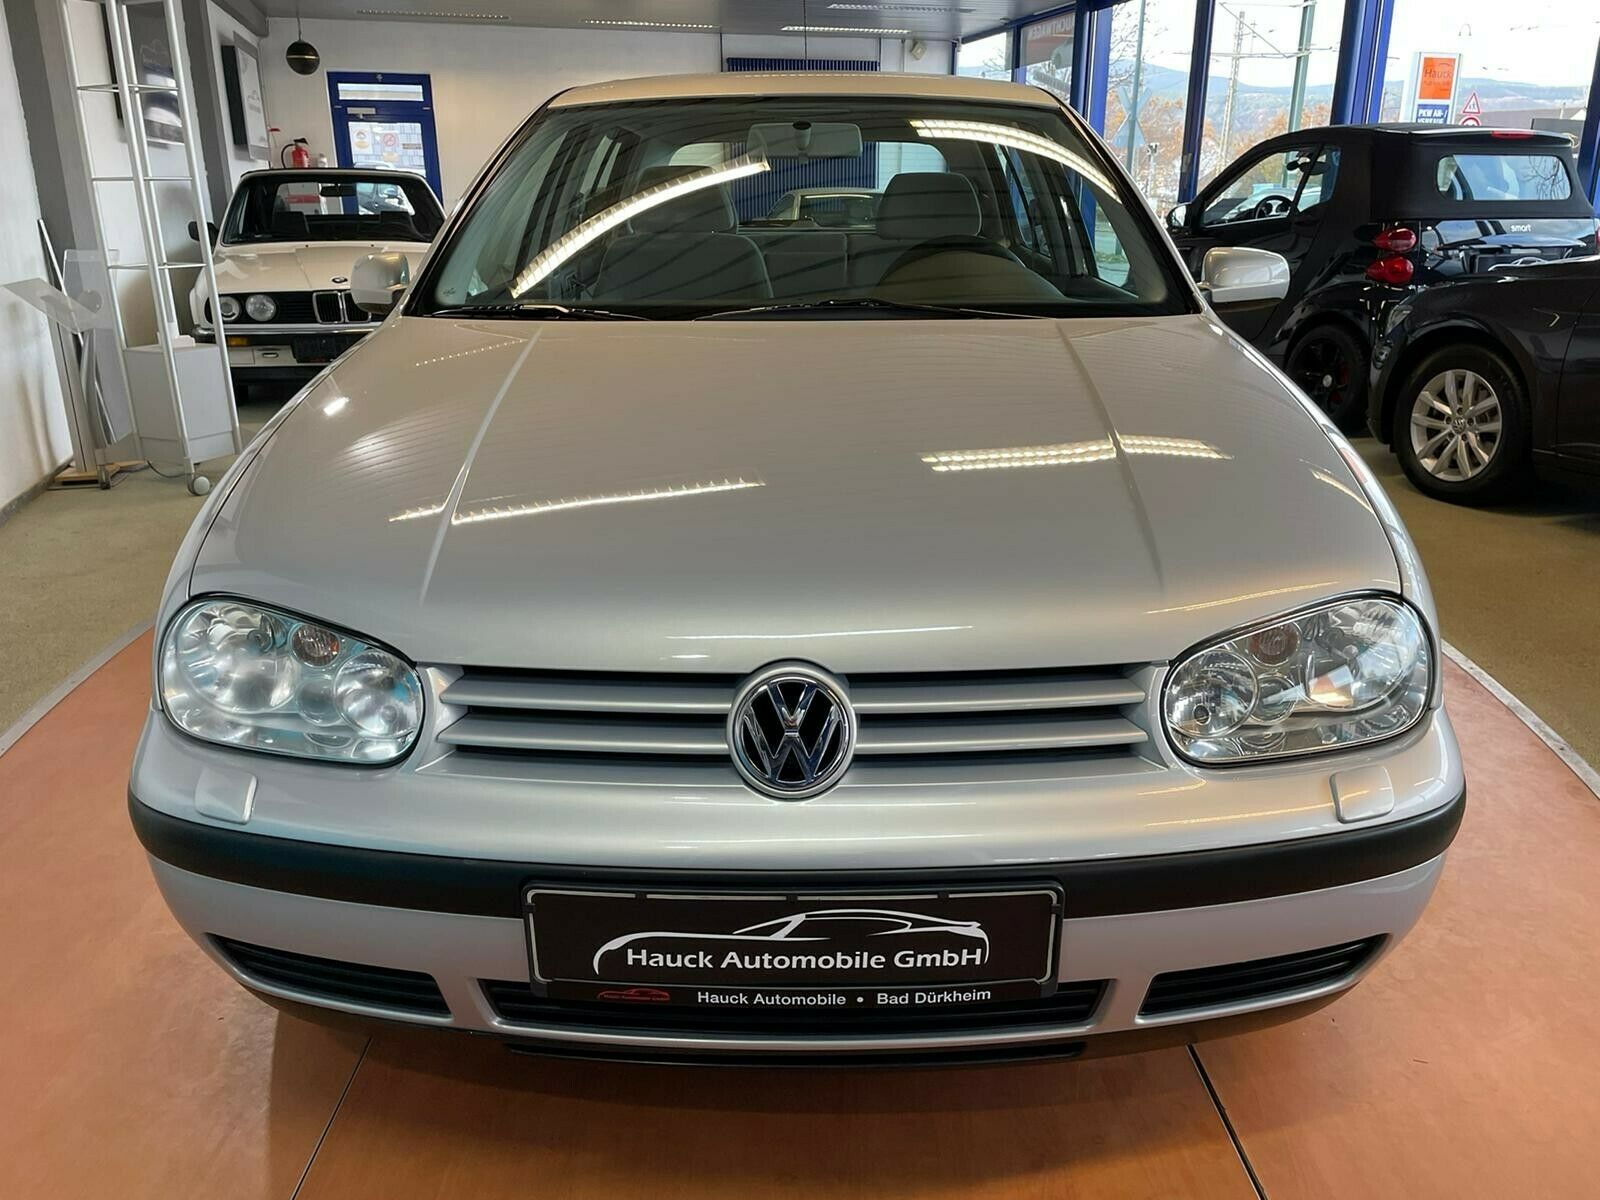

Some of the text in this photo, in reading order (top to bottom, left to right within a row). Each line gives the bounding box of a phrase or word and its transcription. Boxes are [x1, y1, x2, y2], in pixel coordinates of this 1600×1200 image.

[1511, 224, 1532, 232] smart
[739, 676, 848, 787] VW
[627, 948, 982, 969] Hauck Automobile GmbH
[697, 989, 991, 1006] Hauck Automobile Bad Dürkheim
